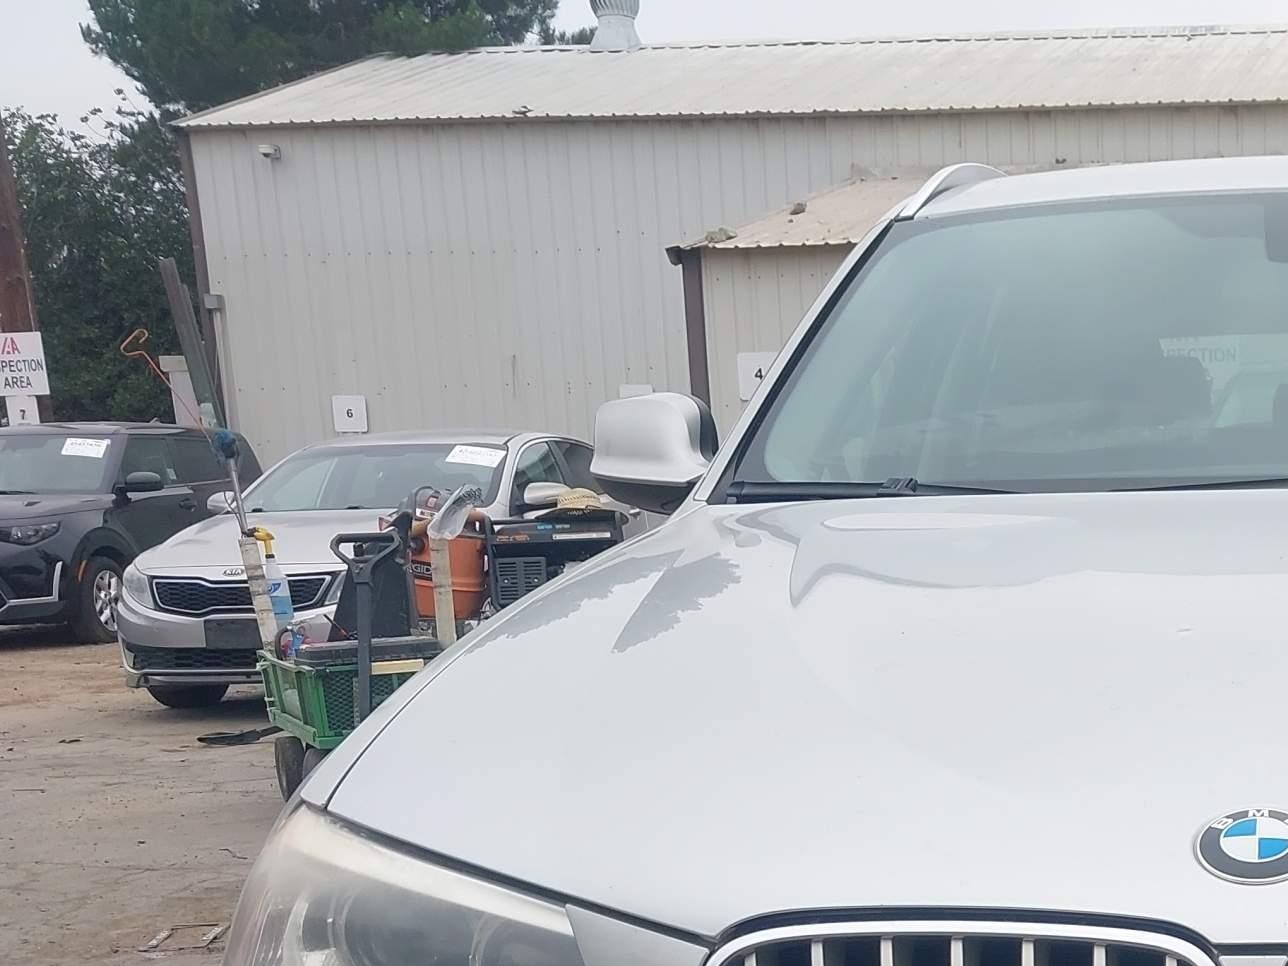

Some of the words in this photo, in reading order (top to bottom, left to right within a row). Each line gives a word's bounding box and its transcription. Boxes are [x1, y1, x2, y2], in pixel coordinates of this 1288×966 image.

[0, 359, 43, 373] PECTION
[754, 367, 764, 380] 4
[4, 375, 33, 389] AREA
[19, 409, 26, 420] 7
[346, 408, 354, 418] 6
